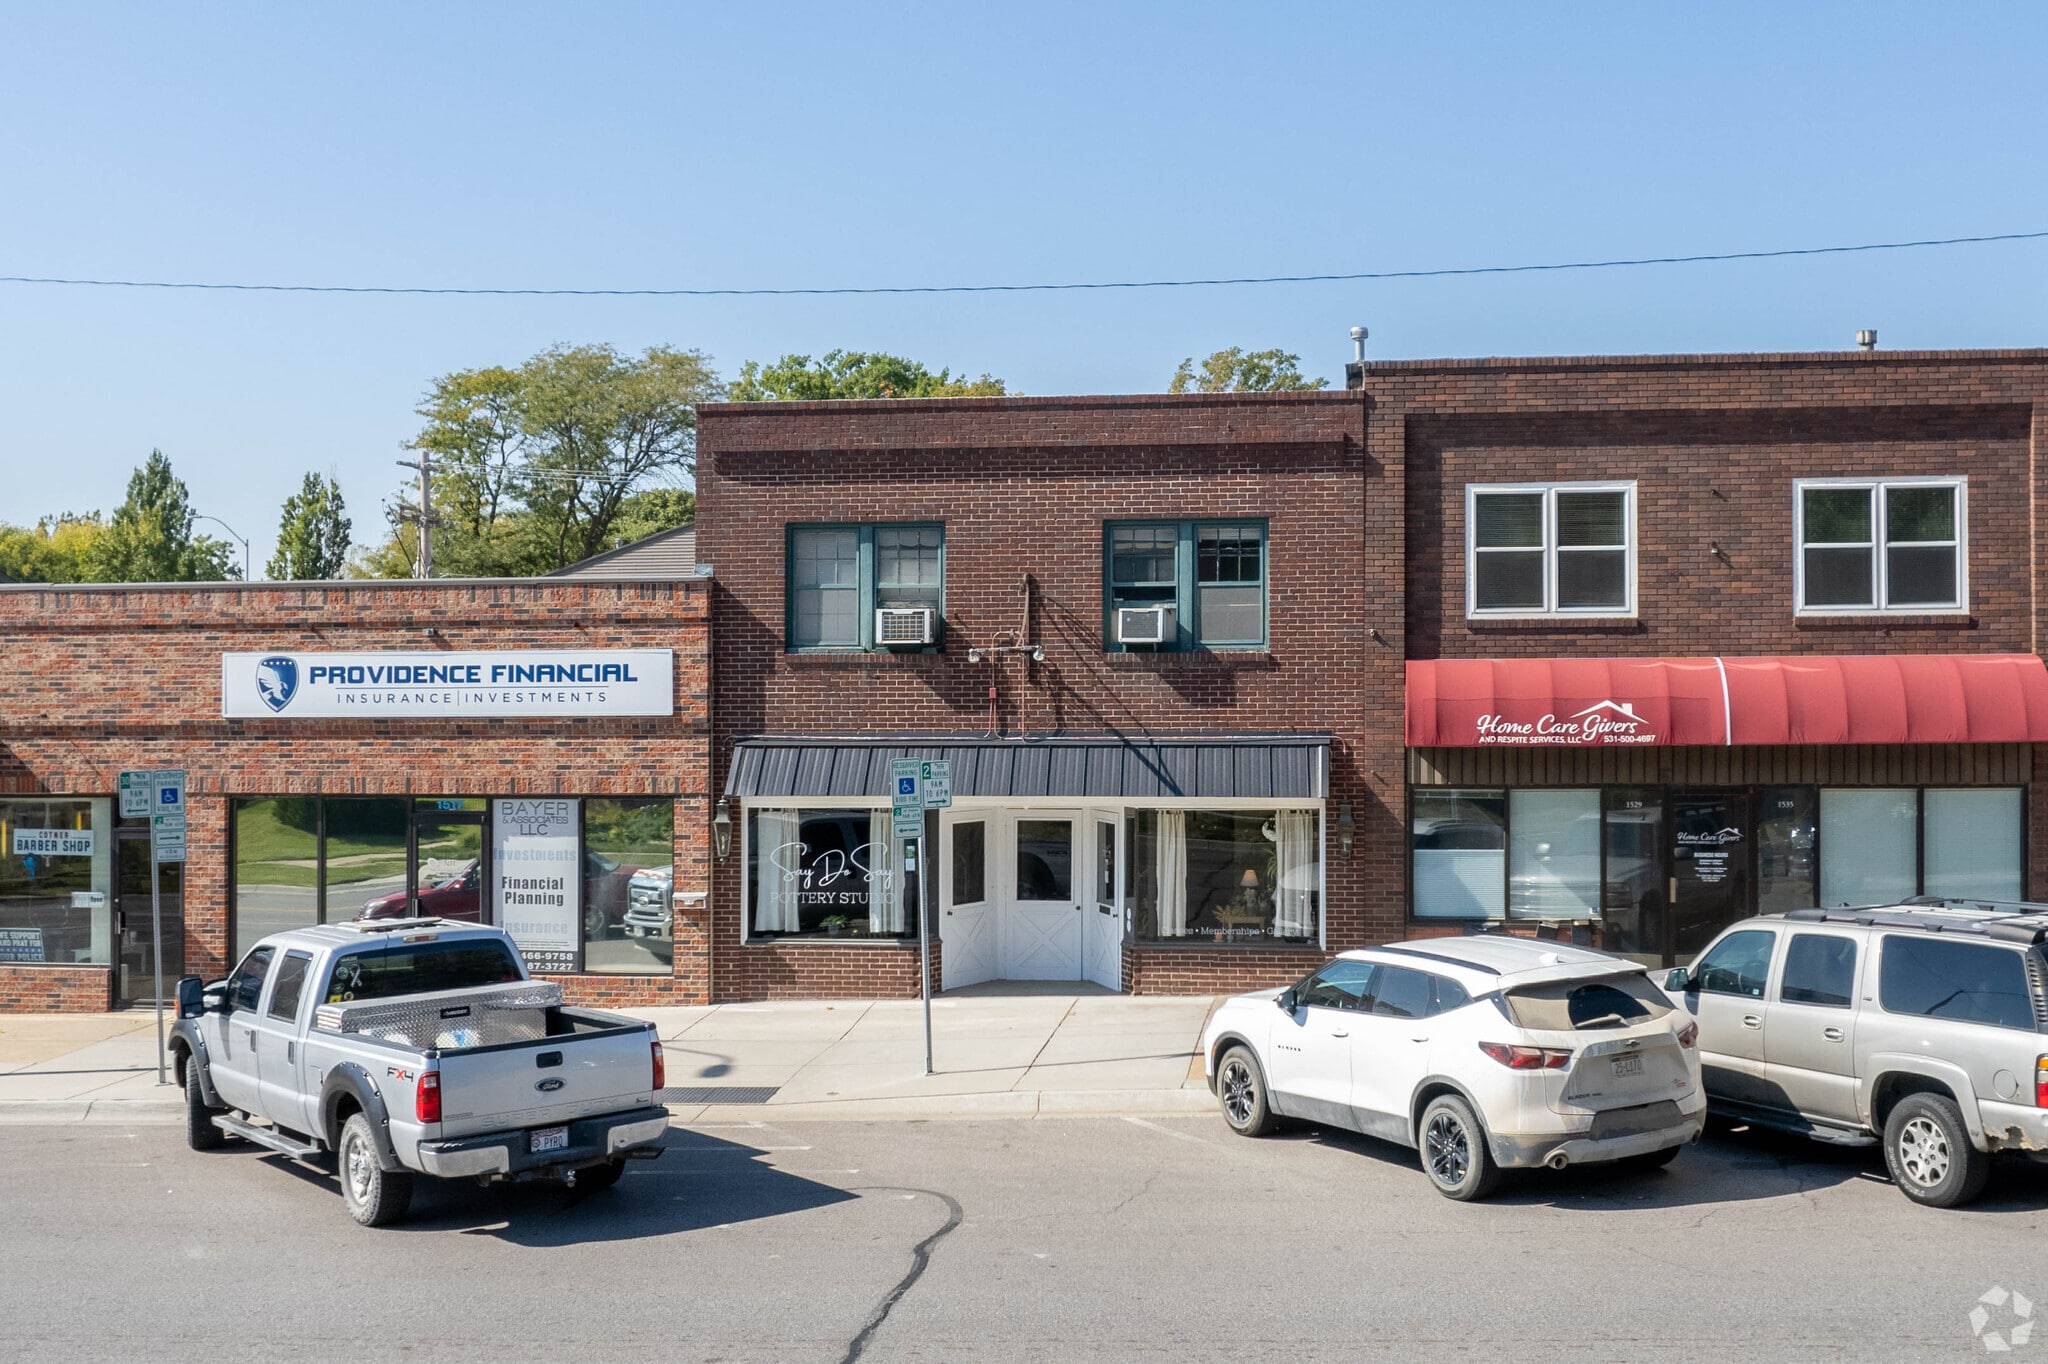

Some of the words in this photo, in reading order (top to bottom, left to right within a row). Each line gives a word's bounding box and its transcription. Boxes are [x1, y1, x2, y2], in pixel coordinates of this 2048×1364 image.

[309, 664, 481, 684] PROVIDENCE
[491, 662, 638, 683] FINANCIAL
[336, 692, 451, 704] INSURANCE
[465, 691, 607, 703] INVESTMENTS
[1476, 714, 1533, 734] Home
[1536, 714, 1580, 734] Care
[1582, 714, 1638, 741] Givers
[1479, 735, 1496, 743] AND
[1603, 734, 1656, 743] 531-500-4697
[923, 765, 930, 777] 2
[930, 780, 944, 788] 9AM
[129, 789, 143, 797] 9AM
[925, 790, 934, 798] TO
[936, 789, 949, 798] 6PM
[125, 799, 133, 807] TO
[502, 801, 569, 816] BAYER
[1626, 801, 1643, 809] 1529
[502, 816, 509, 824] &
[511, 816, 569, 825] ASSOCIATES
[39, 831, 69, 839] COTNER
[520, 824, 548, 836] LLC
[1677, 832, 1699, 841] Home
[1700, 832, 1717, 841] Care
[17, 839, 57, 851] BARBER
[63, 841, 91, 852] SHOP
[493, 847, 576, 862] Investments
[770, 842, 814, 889] Say
[812, 849, 852, 887] Do
[850, 841, 895, 889] Say
[502, 876, 564, 890] Financial
[505, 891, 564, 906] Planning
[770, 892, 836, 904] POTTERY
[839, 892, 896, 904] STUDIO
[10, 931, 41, 940] SUPPORT
[1200, 926, 1260, 936] Memberships
[17, 953, 43, 961] POLICE
[387, 1066, 414, 1083] FX4
